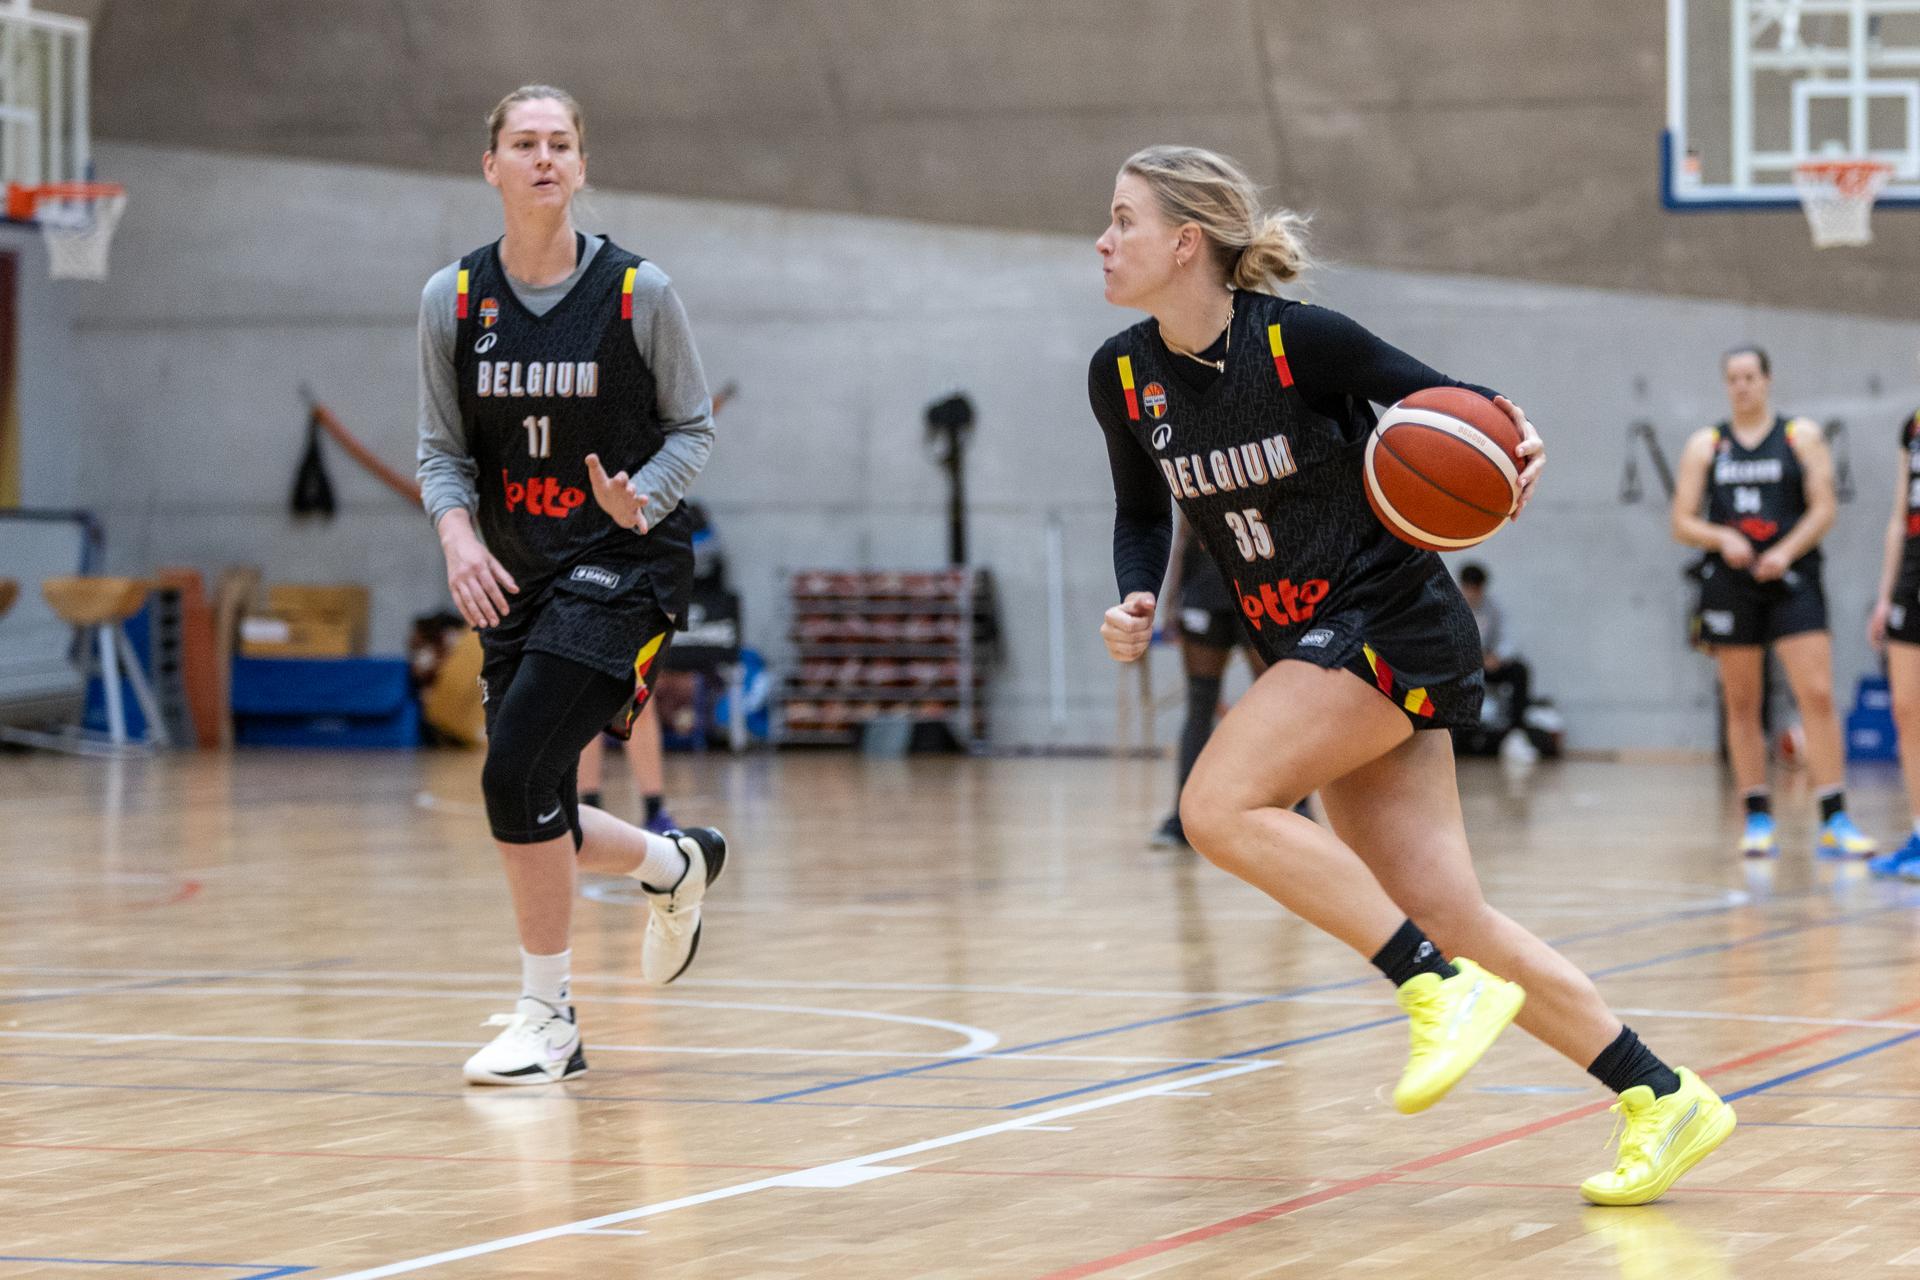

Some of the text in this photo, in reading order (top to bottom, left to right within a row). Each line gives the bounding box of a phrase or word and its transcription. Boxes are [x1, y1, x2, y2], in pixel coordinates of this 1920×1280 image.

[477, 362, 599, 397] BELGIUM
[523, 415, 550, 458] 11
[503, 467, 586, 518] lotto
[1160, 434, 1297, 499] BELGIUM
[1225, 508, 1275, 562] 35
[1233, 576, 1329, 632] lotto
